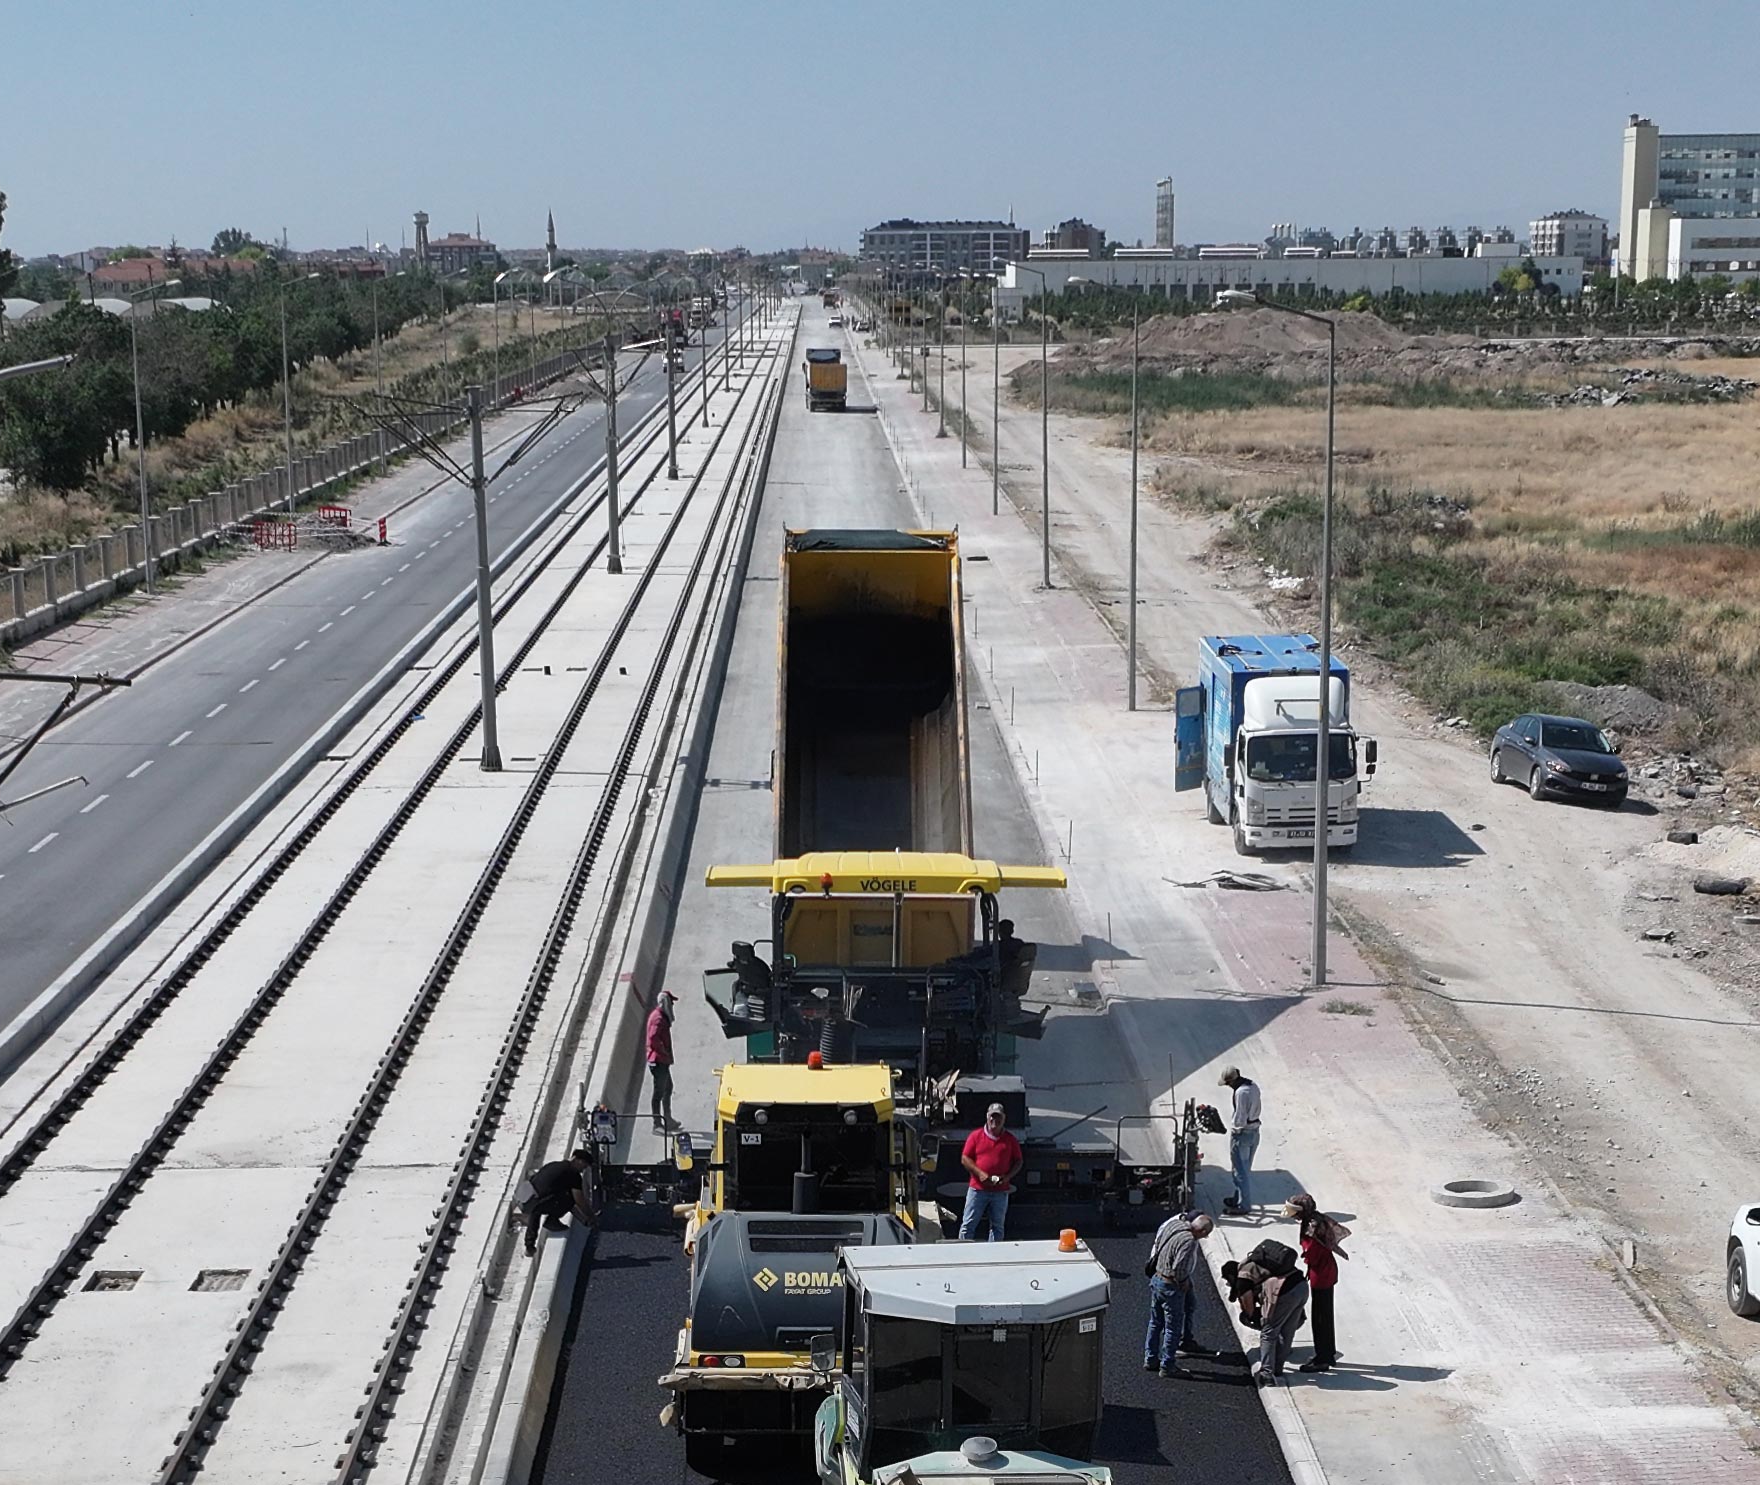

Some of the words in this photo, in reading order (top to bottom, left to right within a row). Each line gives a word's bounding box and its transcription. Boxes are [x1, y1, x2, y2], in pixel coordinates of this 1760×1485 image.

[860, 875, 917, 893] VÖGELE
[743, 1135, 760, 1143] V-1
[784, 1271, 845, 1288] BOMA
